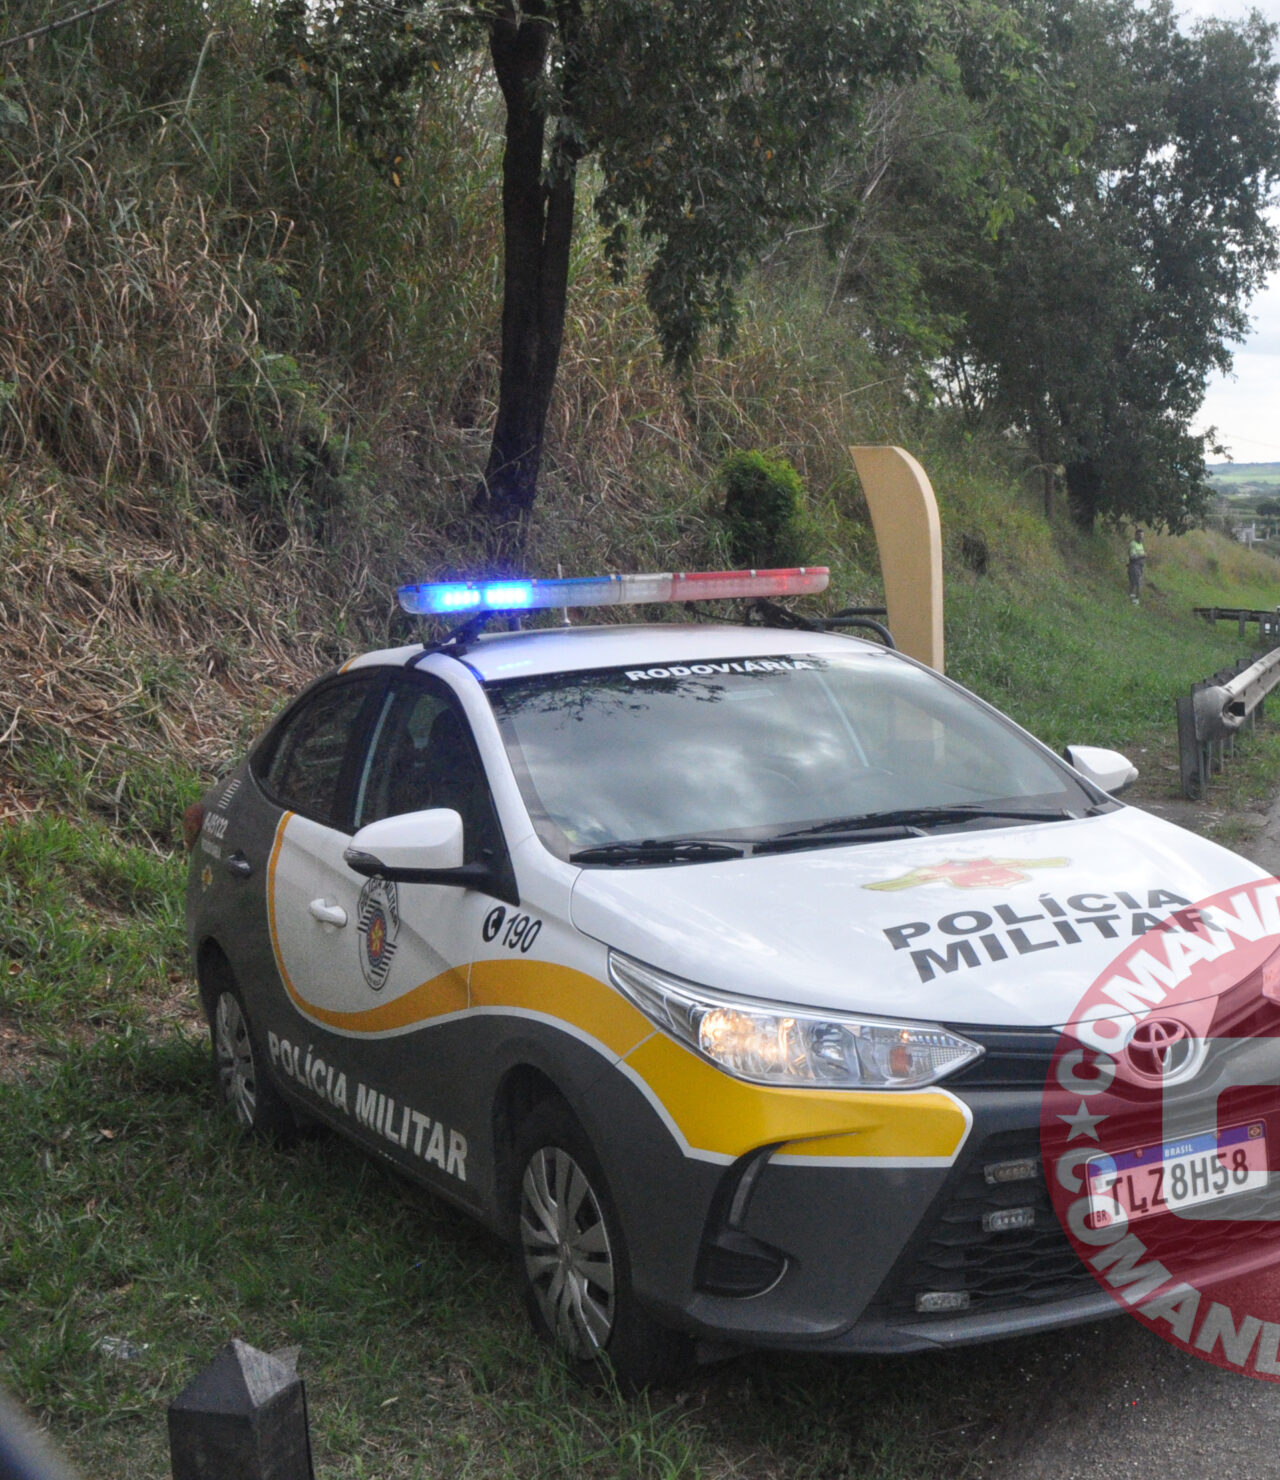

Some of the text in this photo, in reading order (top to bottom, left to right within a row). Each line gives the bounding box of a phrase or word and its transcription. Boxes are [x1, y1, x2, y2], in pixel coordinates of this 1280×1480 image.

[502, 913, 542, 953] 190
[883, 889, 1196, 950] POLÍCIA
[909, 908, 1227, 983] MILITAR
[268, 1031, 468, 1182] POLÍCIA MILITAR
[1164, 1143, 1194, 1158] BRASIL
[1106, 1148, 1249, 1217] TLZ8H58
[1096, 1209, 1107, 1223] BR
